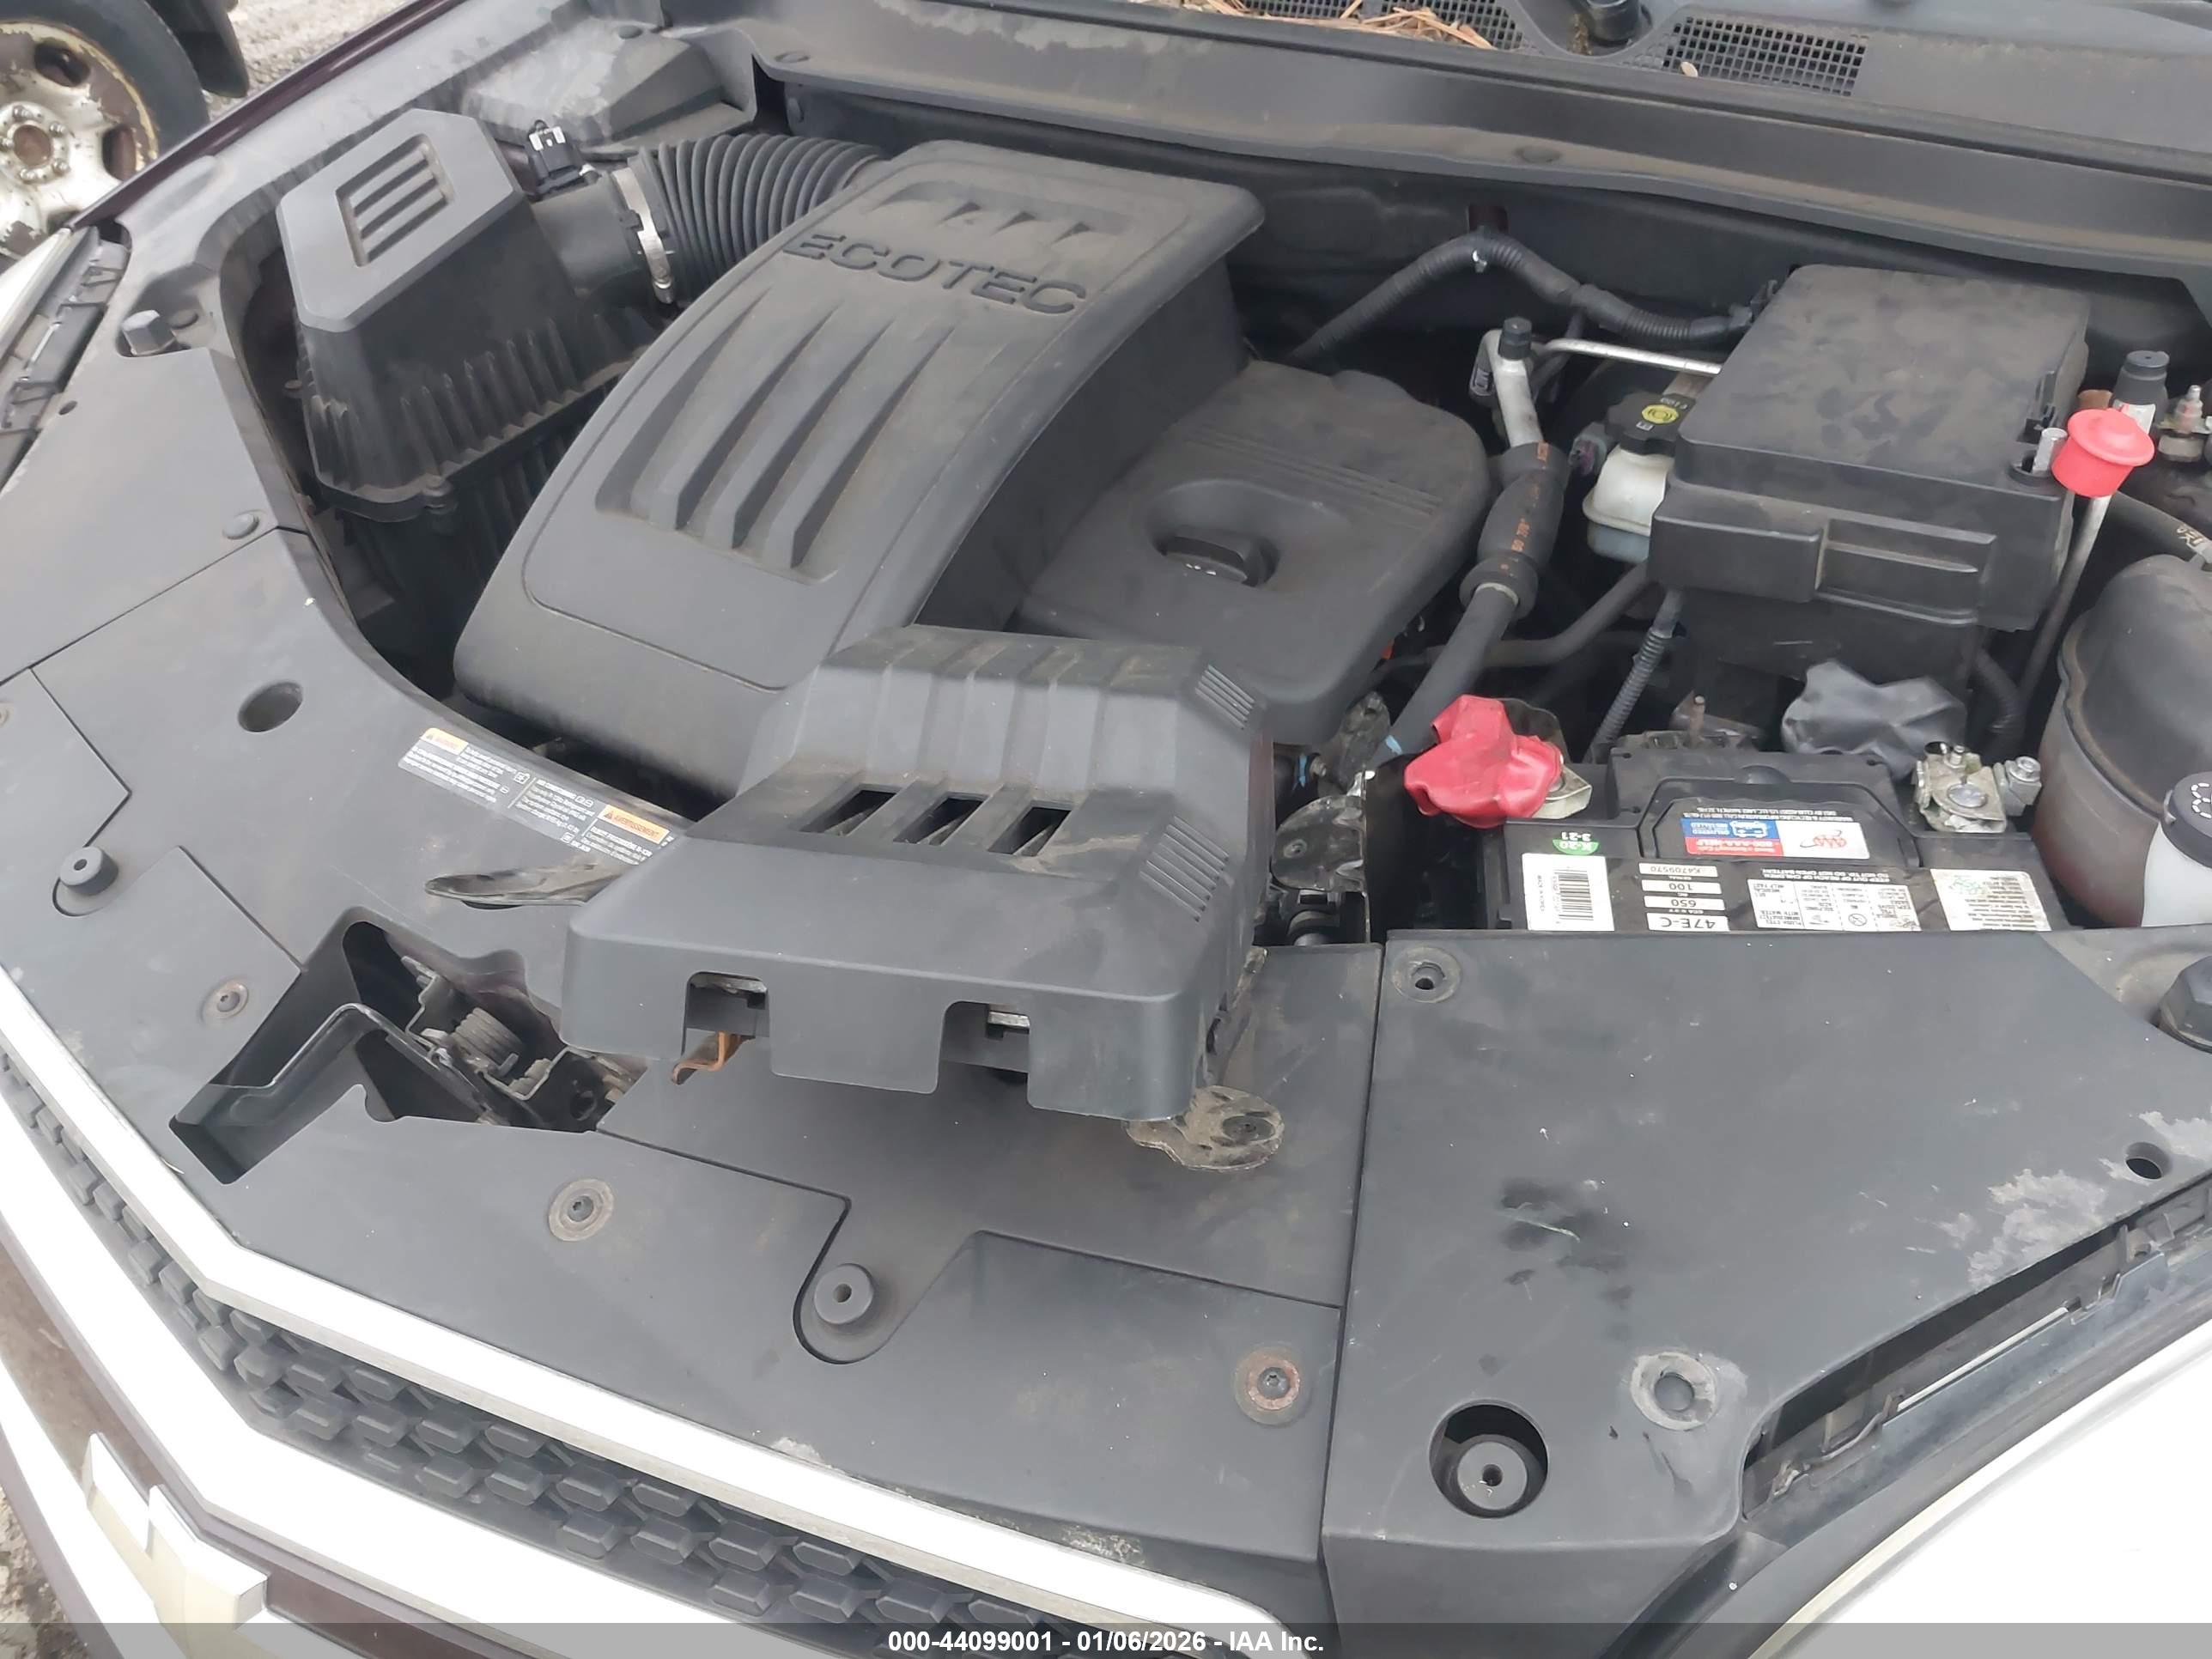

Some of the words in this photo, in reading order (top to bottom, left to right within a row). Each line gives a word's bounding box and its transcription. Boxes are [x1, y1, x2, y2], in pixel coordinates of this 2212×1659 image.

[781, 233, 1087, 315] ECOTEC
[1560, 831, 1591, 842] 3-21
[1670, 898, 1697, 908] 650
[1659, 917, 1716, 930] 47E-C
